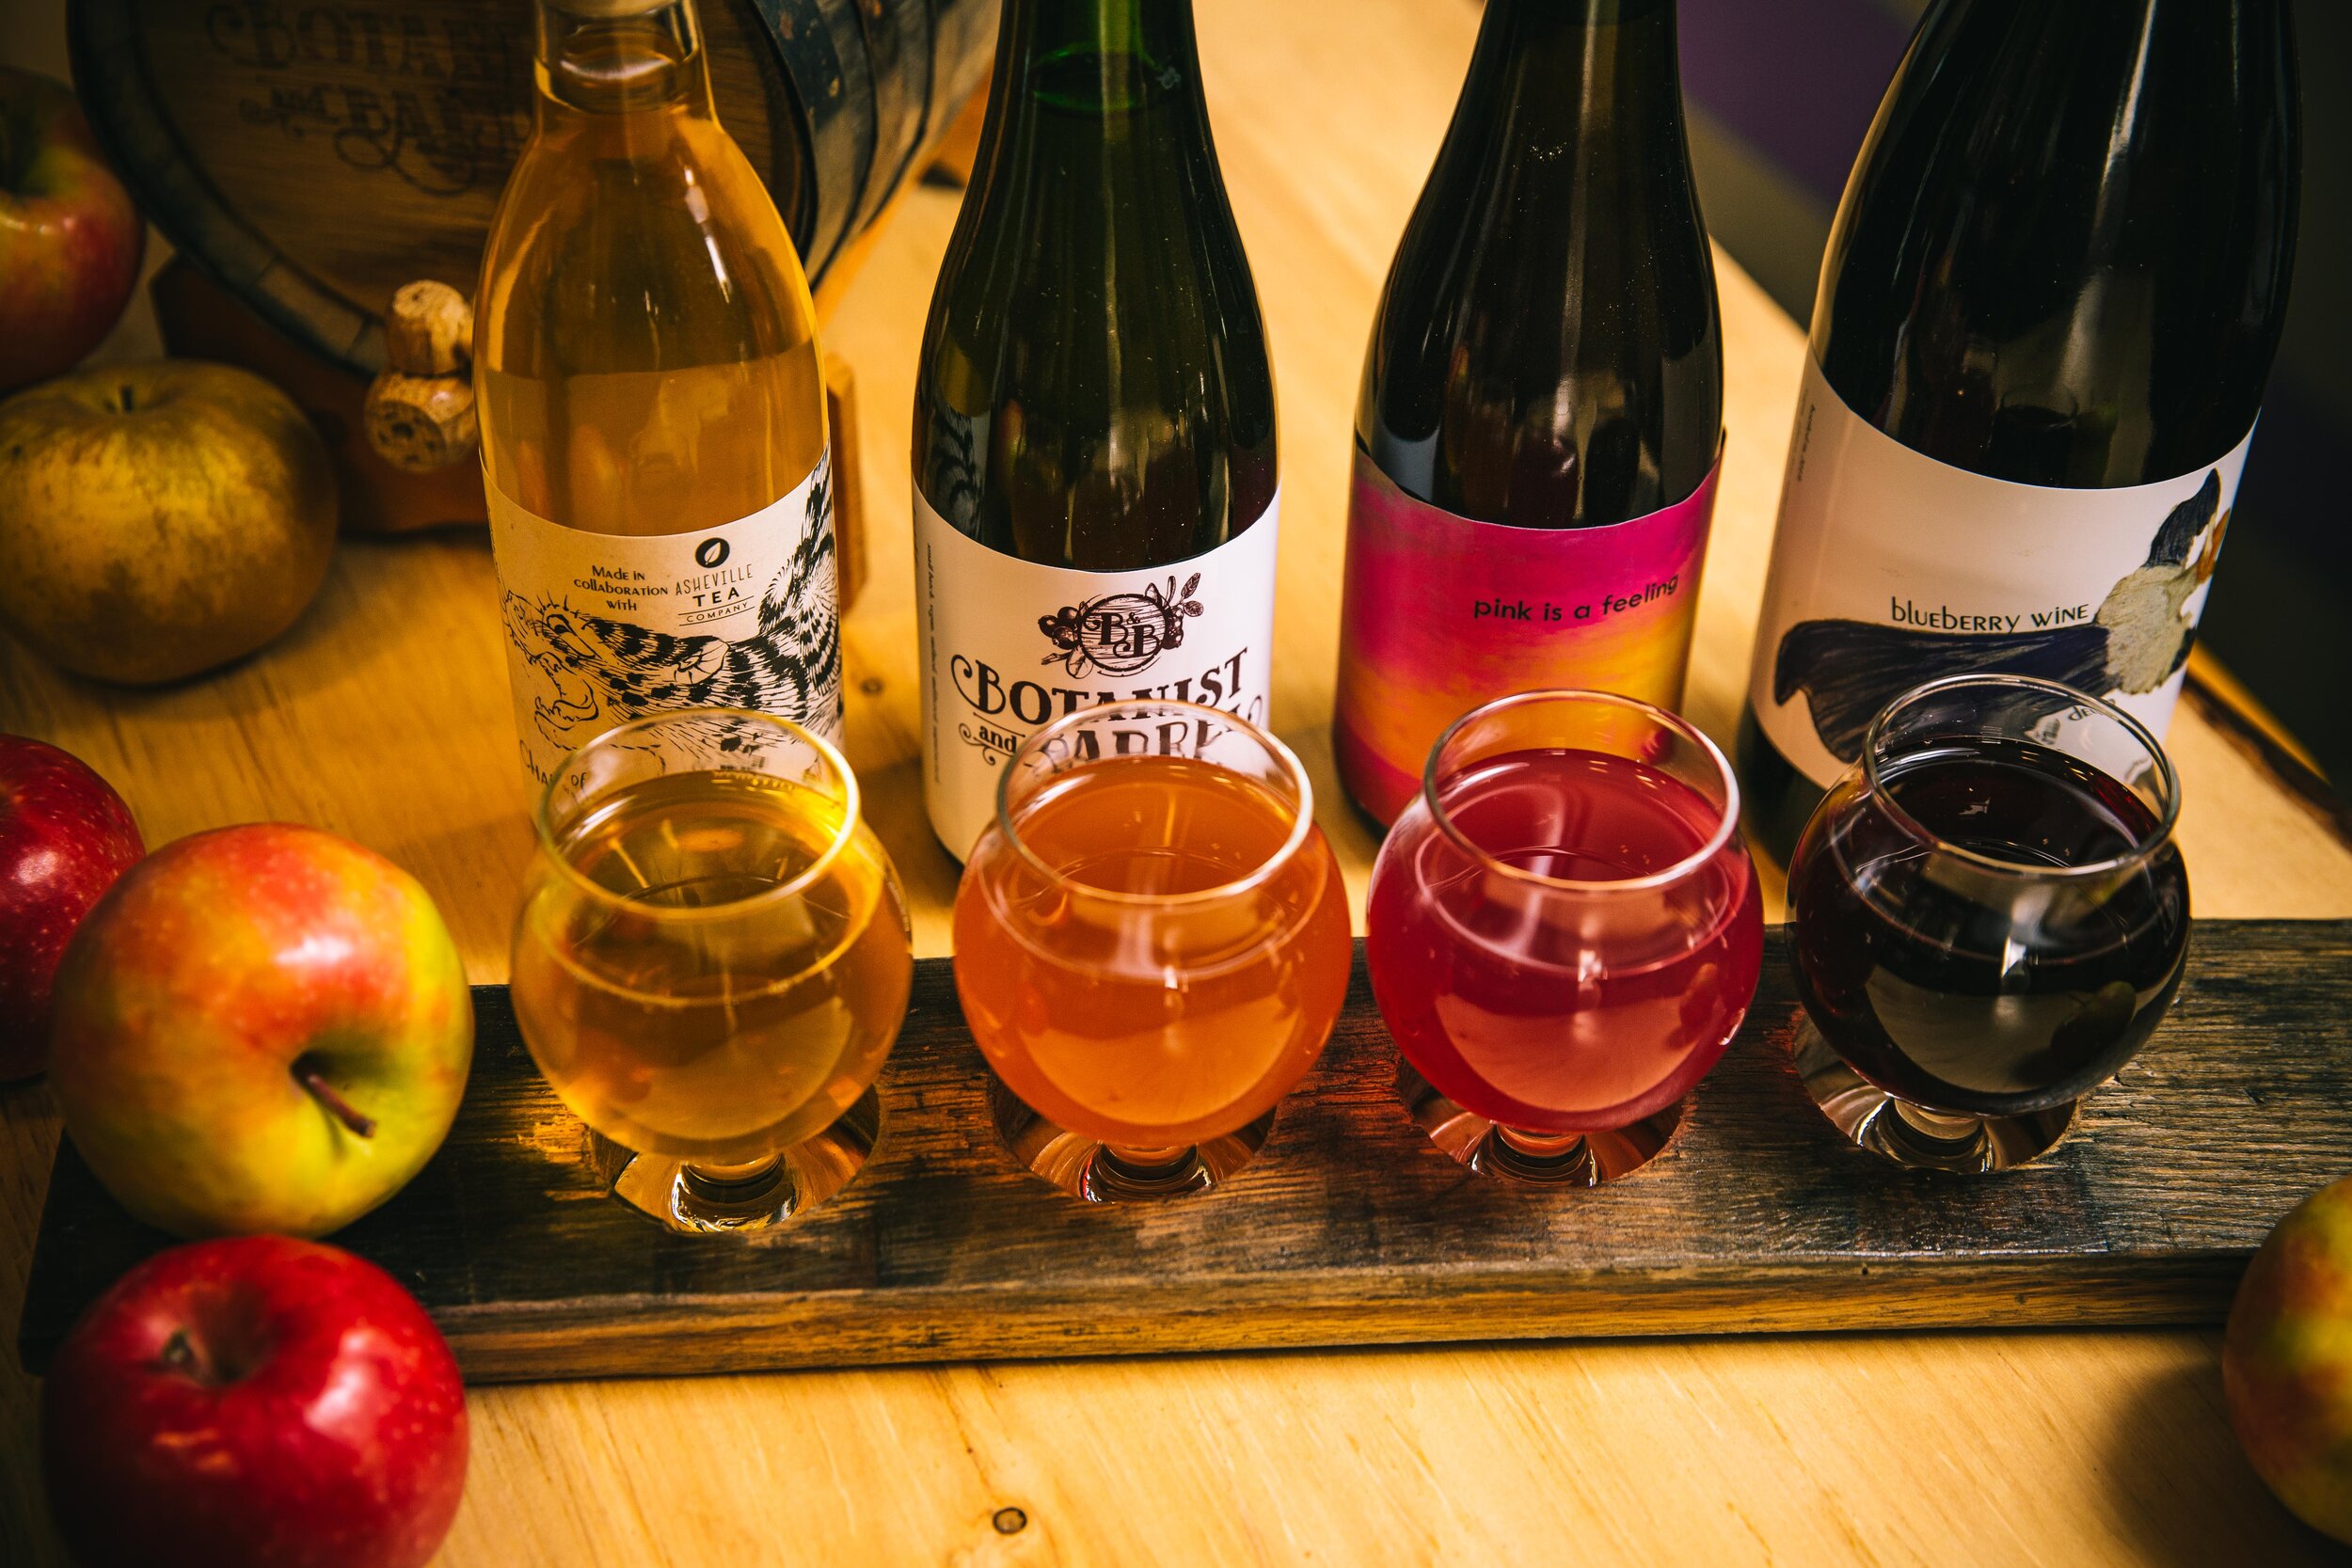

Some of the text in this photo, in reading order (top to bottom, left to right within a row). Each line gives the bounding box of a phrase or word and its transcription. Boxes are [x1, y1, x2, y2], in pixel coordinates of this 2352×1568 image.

[675, 563, 754, 596] ASHEVILLE
[685, 601, 749, 623] COMPANY
[691, 586, 740, 608] TEA
[1473, 574, 1679, 621] pink is a feeling
[950, 646, 1248, 725] BOTANIST
[978, 724, 1018, 754] and
